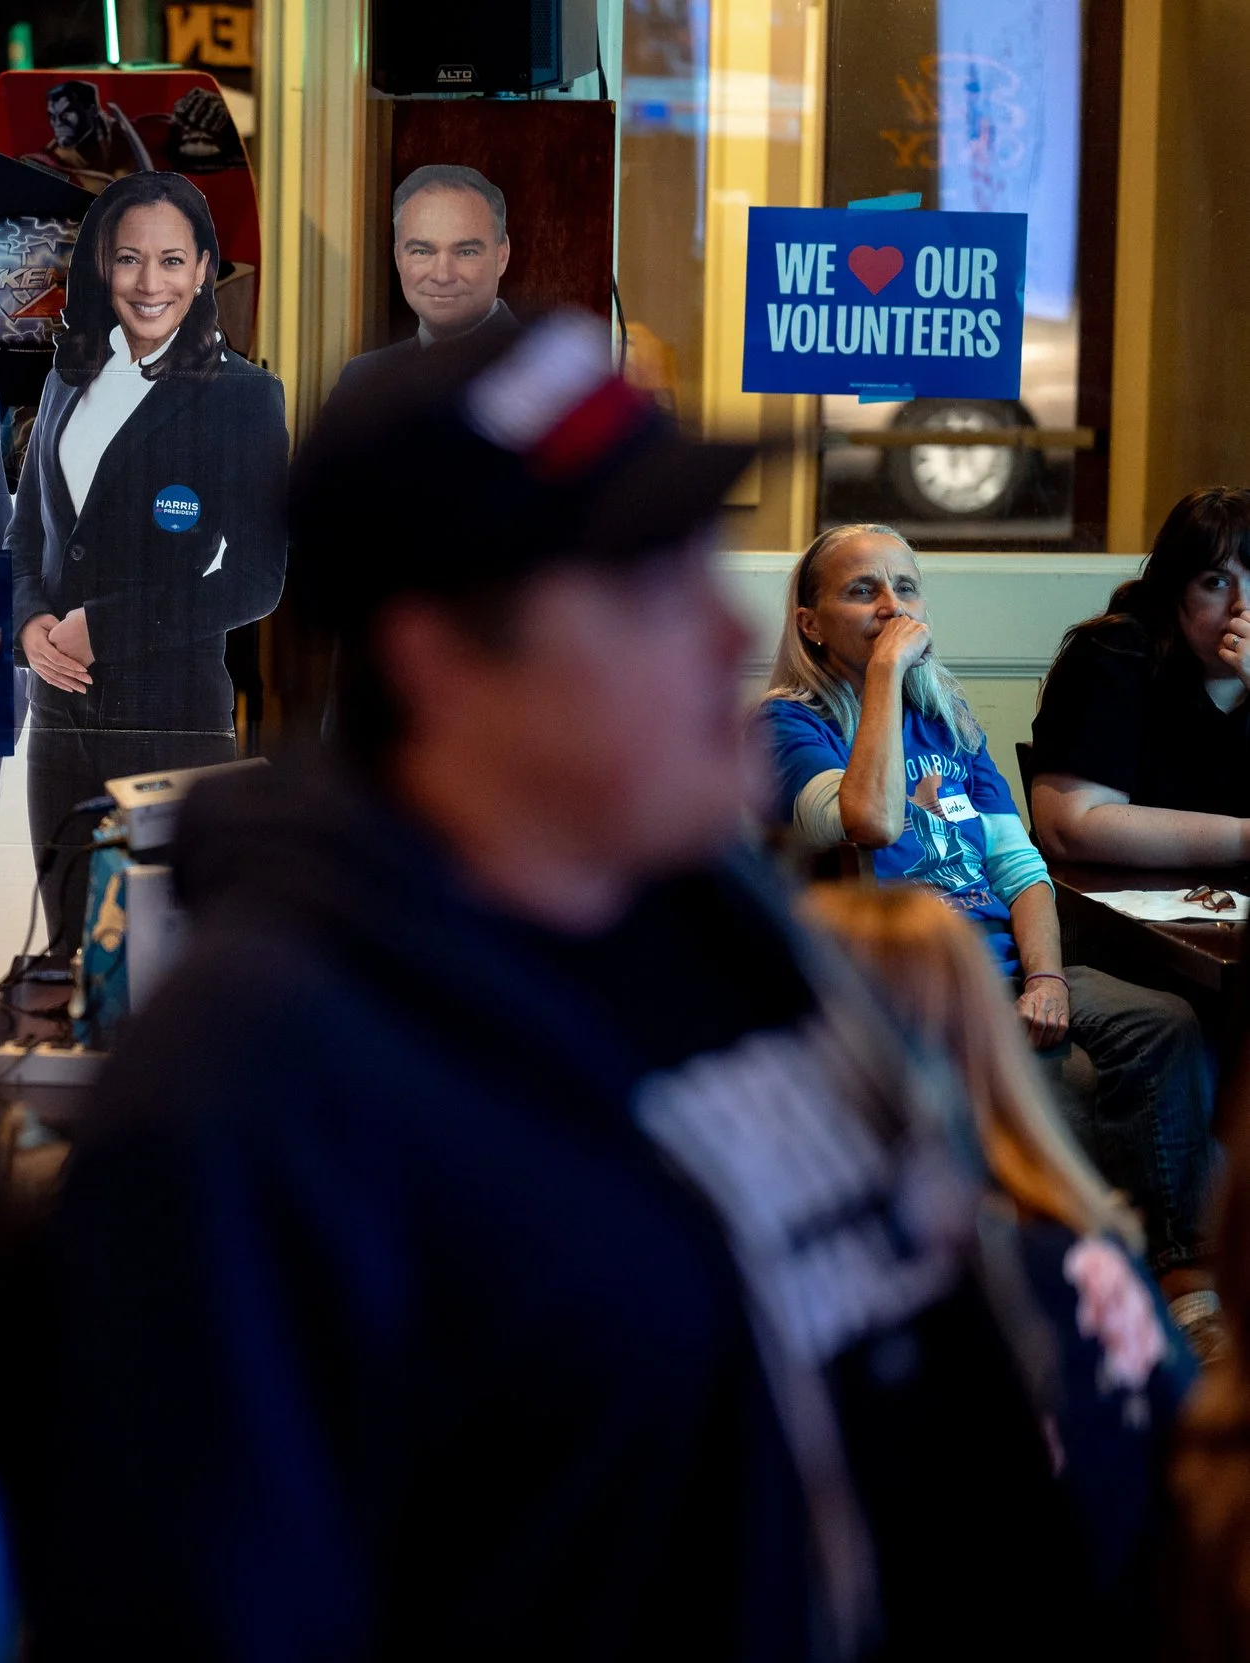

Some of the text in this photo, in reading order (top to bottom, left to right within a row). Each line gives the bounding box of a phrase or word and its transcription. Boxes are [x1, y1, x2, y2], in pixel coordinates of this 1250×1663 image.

[437, 69, 472, 79] ALTO
[775, 242, 998, 300] WE OUR
[767, 303, 1001, 358] VOLUNTEERS
[155, 499, 199, 511] HARRIS
[163, 508, 198, 516] PRESIDENT
